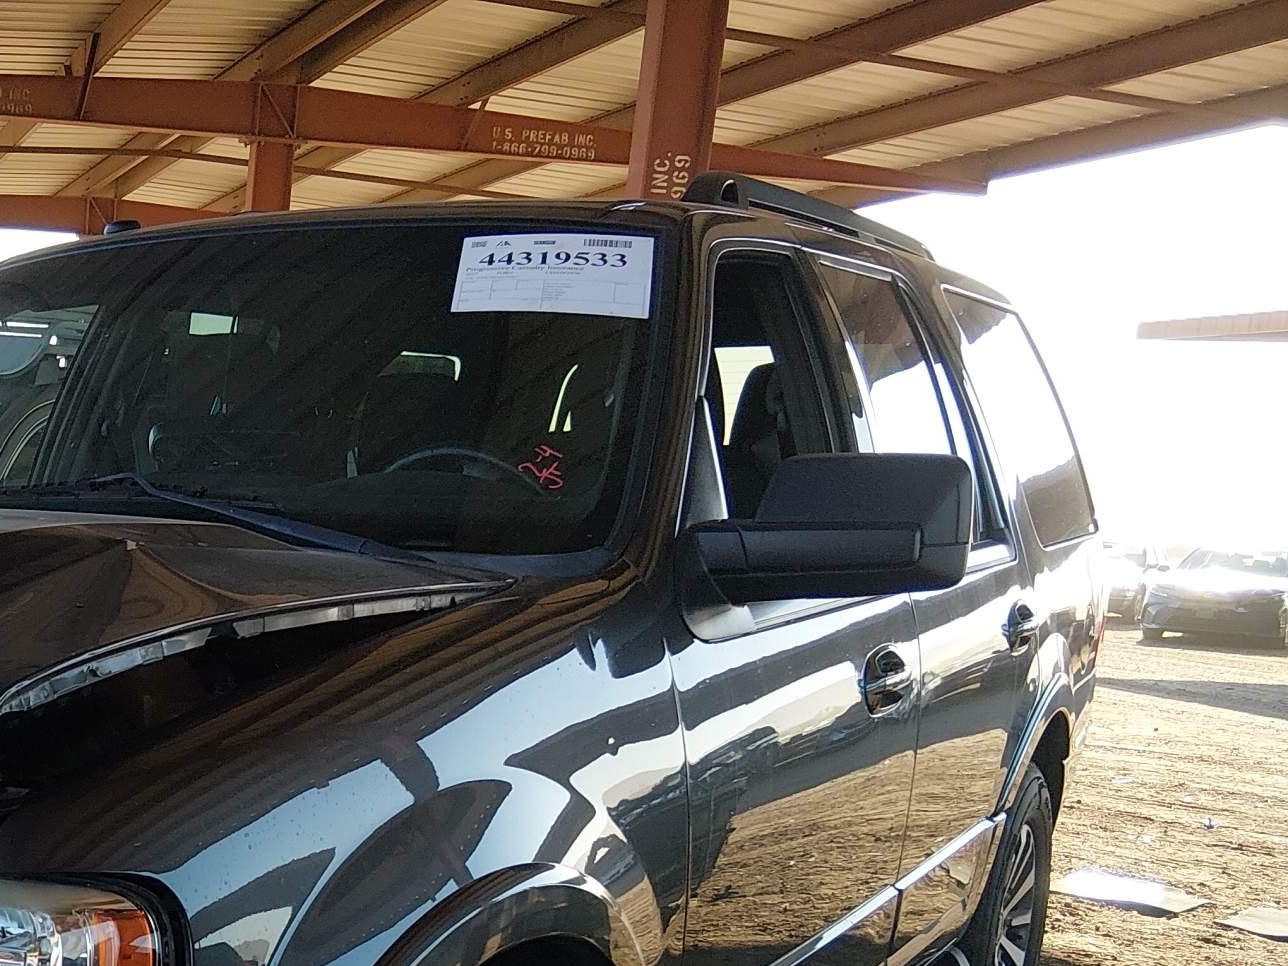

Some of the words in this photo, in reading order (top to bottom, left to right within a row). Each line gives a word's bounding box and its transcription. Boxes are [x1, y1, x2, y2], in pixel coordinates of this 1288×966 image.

[522, 129, 569, 144] PREFAB
[574, 133, 597, 146] INC.
[492, 141, 595, 160] 1-866-799-0969
[650, 152, 672, 194] INC.
[479, 250, 628, 268] 44319533
